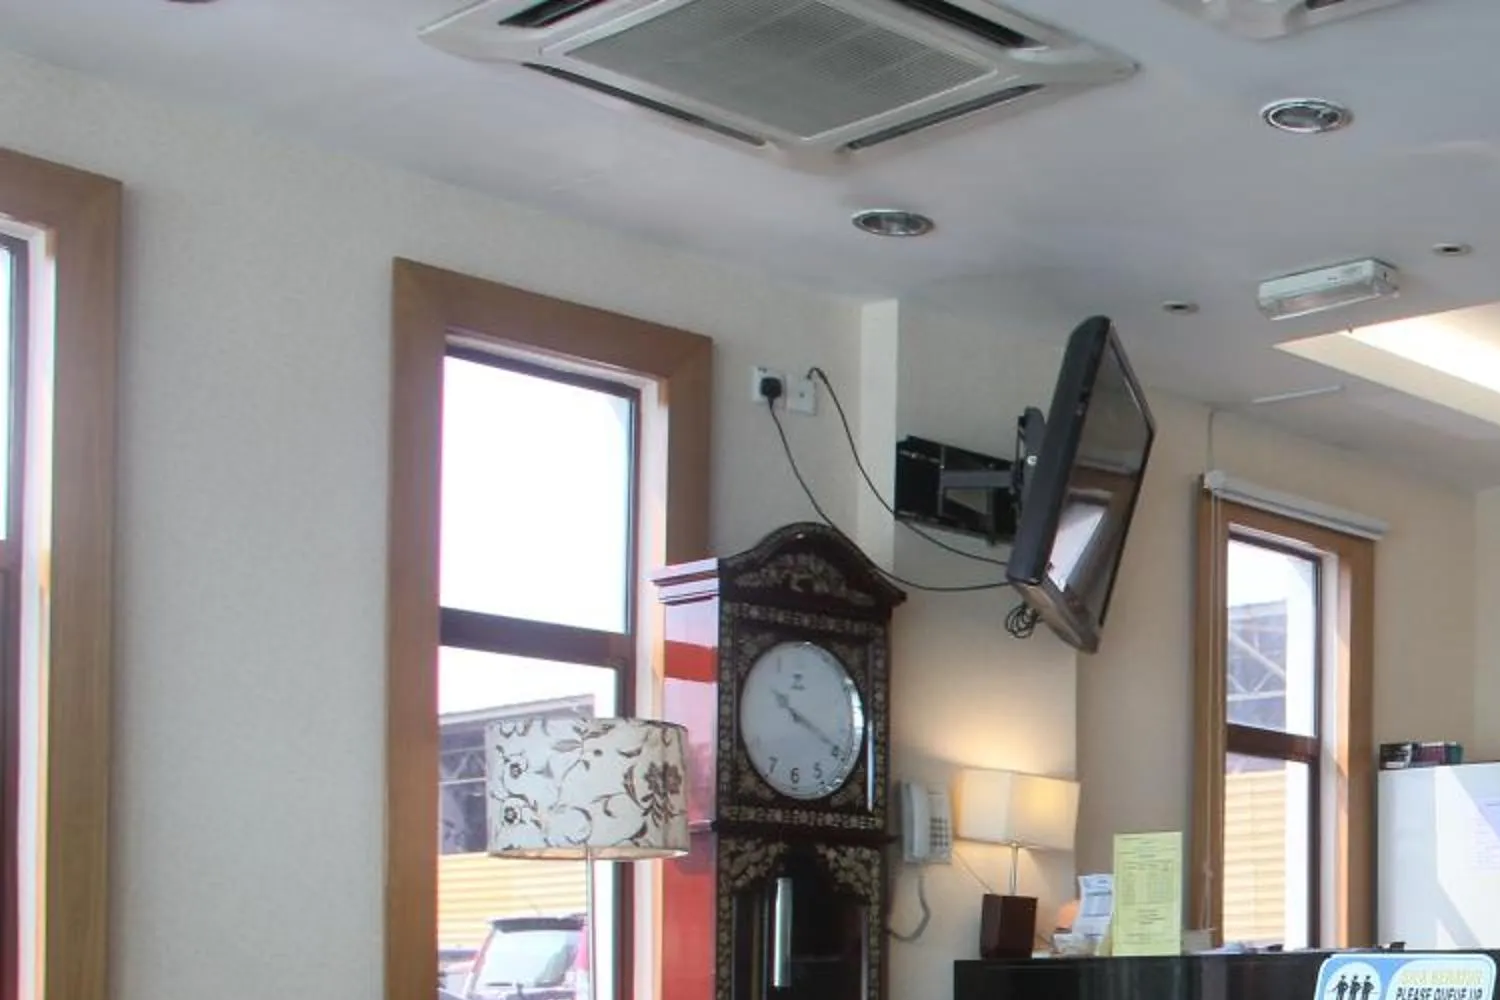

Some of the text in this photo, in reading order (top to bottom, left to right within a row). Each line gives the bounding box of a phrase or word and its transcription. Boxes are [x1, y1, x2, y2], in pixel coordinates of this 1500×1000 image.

[767, 756, 779, 773] 7
[812, 762, 823, 779] 5
[790, 767, 800, 785] 6
